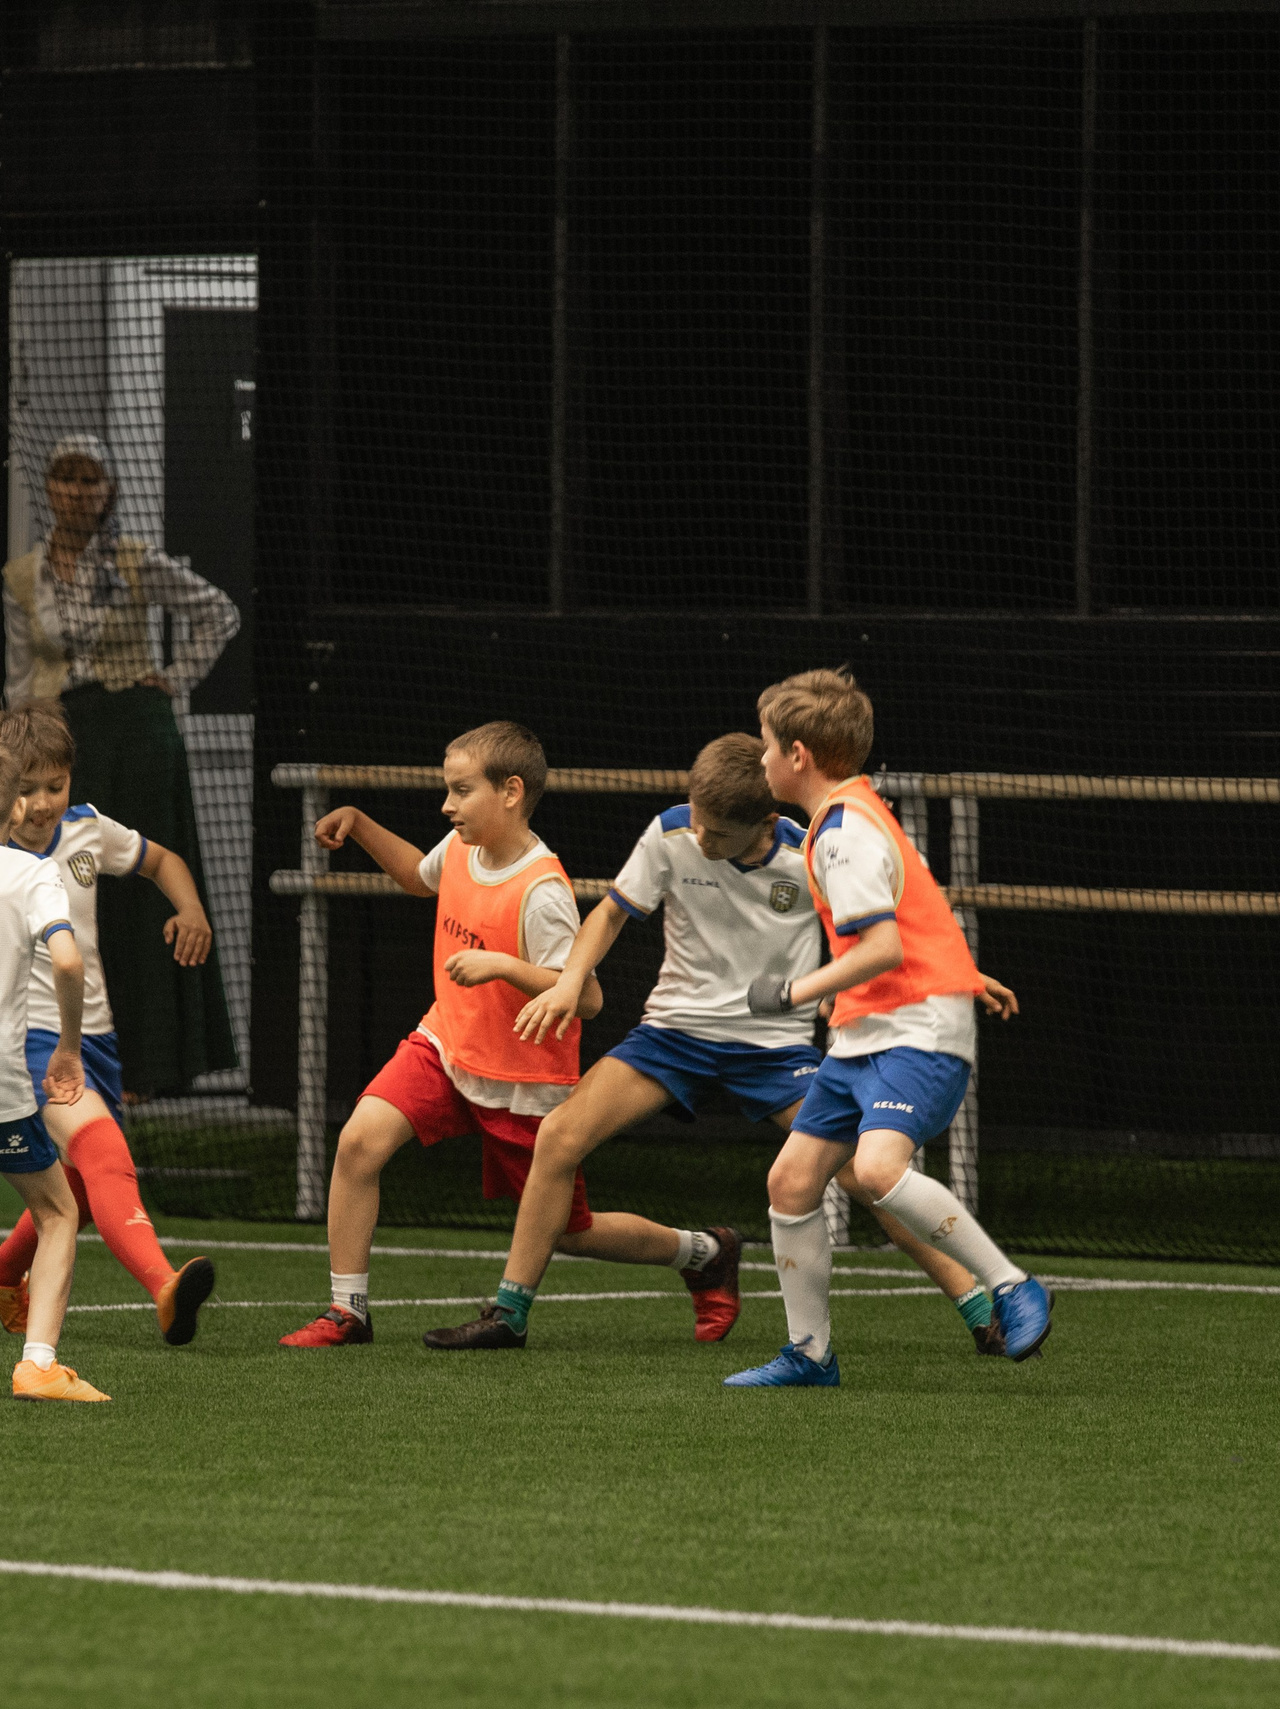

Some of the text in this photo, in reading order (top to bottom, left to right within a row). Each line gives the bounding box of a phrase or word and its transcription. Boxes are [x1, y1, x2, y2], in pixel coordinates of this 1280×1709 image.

[682, 877, 720, 888] KELME
[442, 914, 486, 951] KIPSTA
[872, 1100, 914, 1114] KELME
